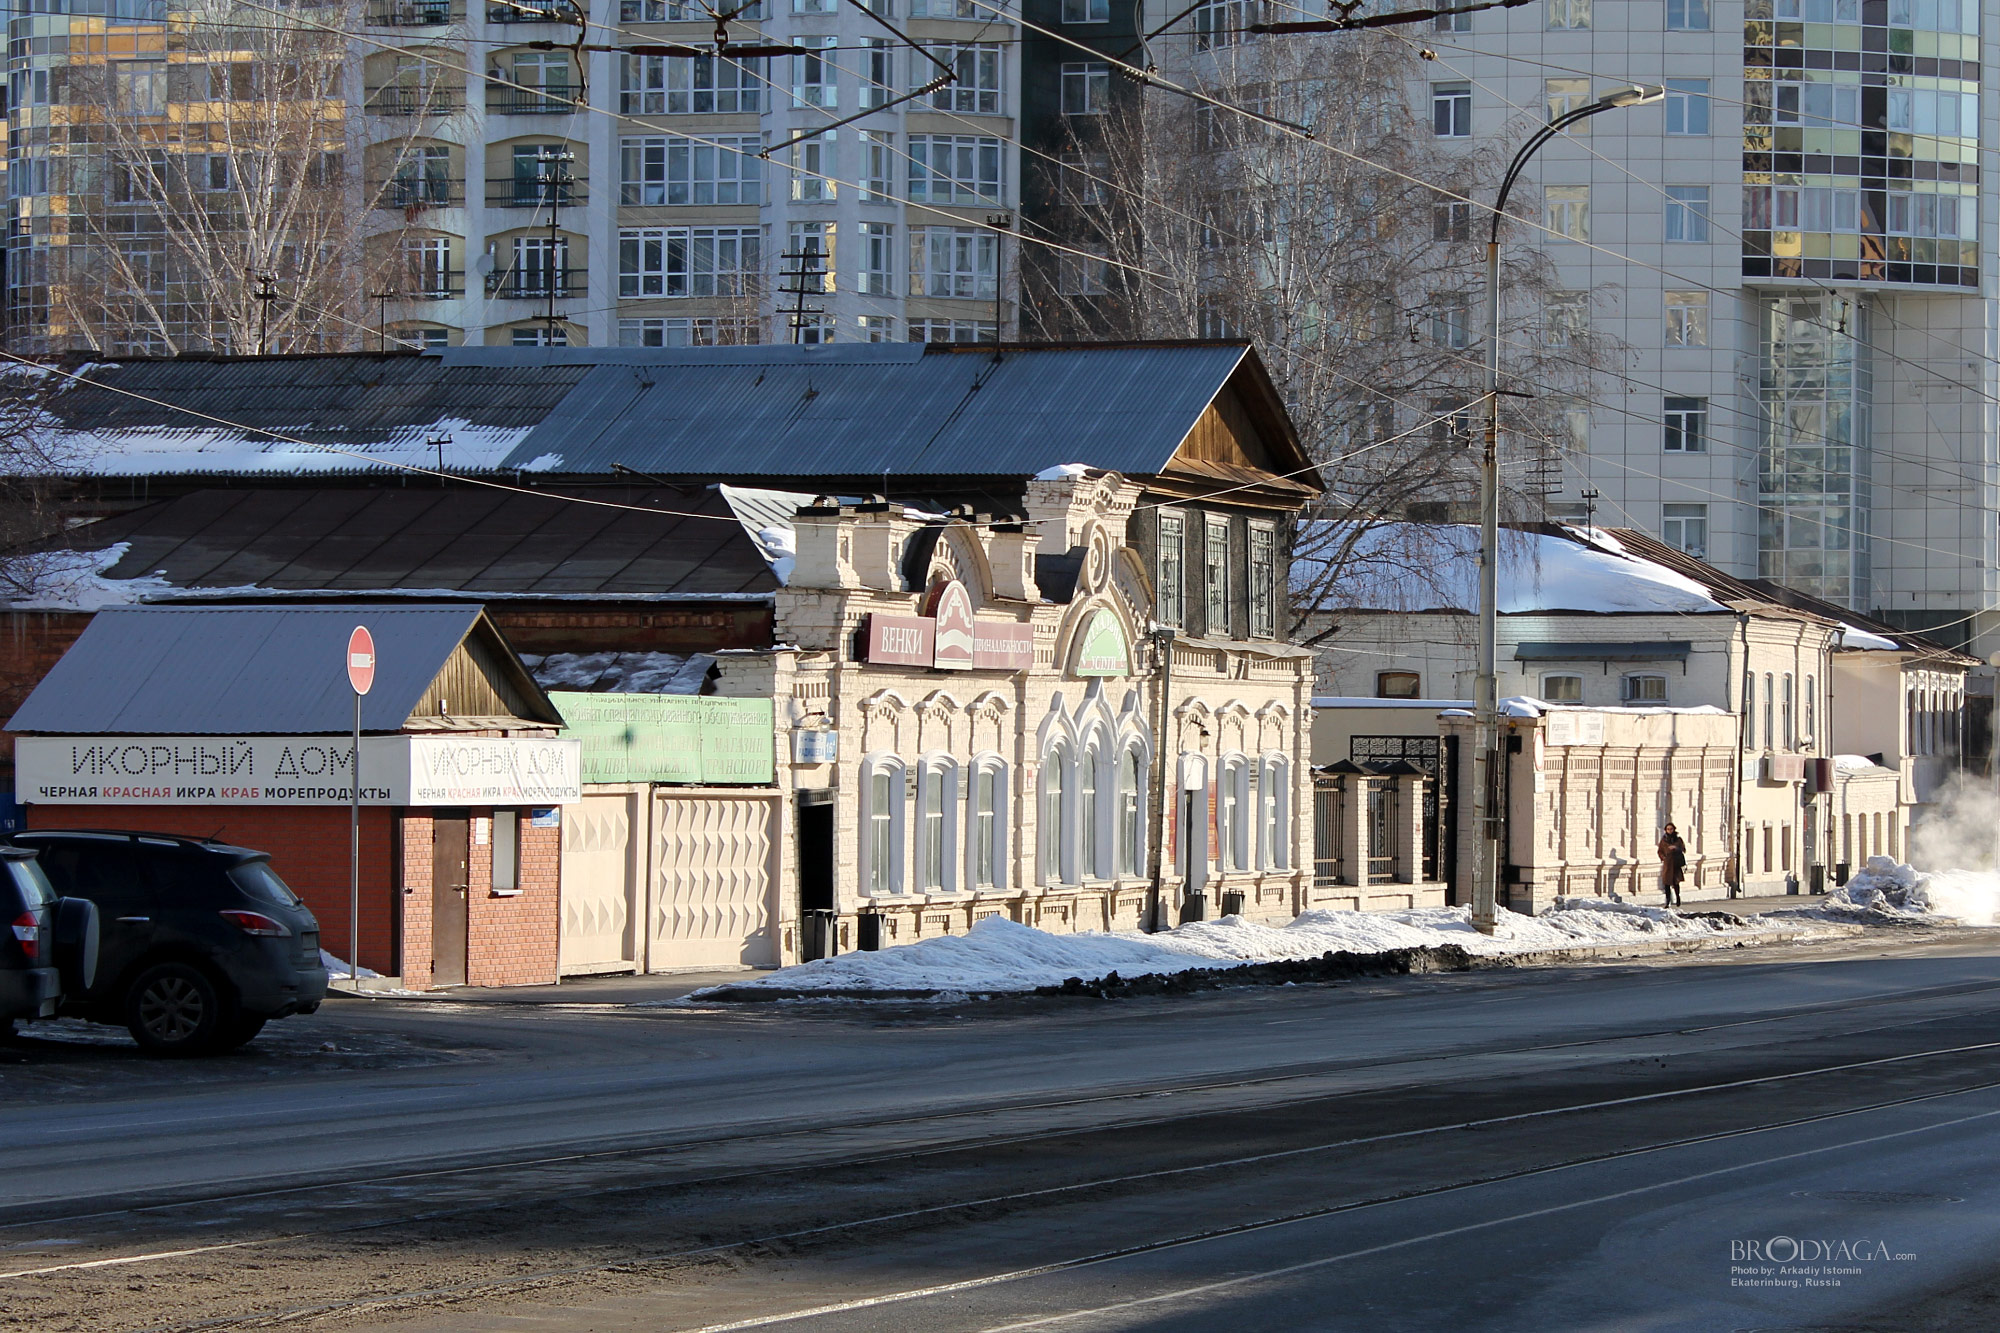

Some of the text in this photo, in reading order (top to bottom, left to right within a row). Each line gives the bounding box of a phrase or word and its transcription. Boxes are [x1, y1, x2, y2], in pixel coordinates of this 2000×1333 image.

[881, 626, 923, 655] ВЕНКИ
[974, 638, 1033, 654] ПРИНАДЛЕЖНОСТИ
[71, 740, 355, 780] ИКОРНЫЙ ДОМ
[433, 741, 564, 779] ИКОРНЫЙ ДОМ
[39, 786, 98, 798] ЧЕРНАЯ
[102, 786, 172, 799] КРАСНАЯ
[176, 787, 216, 799] ИКРА
[221, 787, 260, 799] КРАБ
[417, 787, 446, 799] ЧЕРНАЯ
[447, 787, 481, 799] КРАСНАЯ
[482, 787, 501, 798] ИКРА
